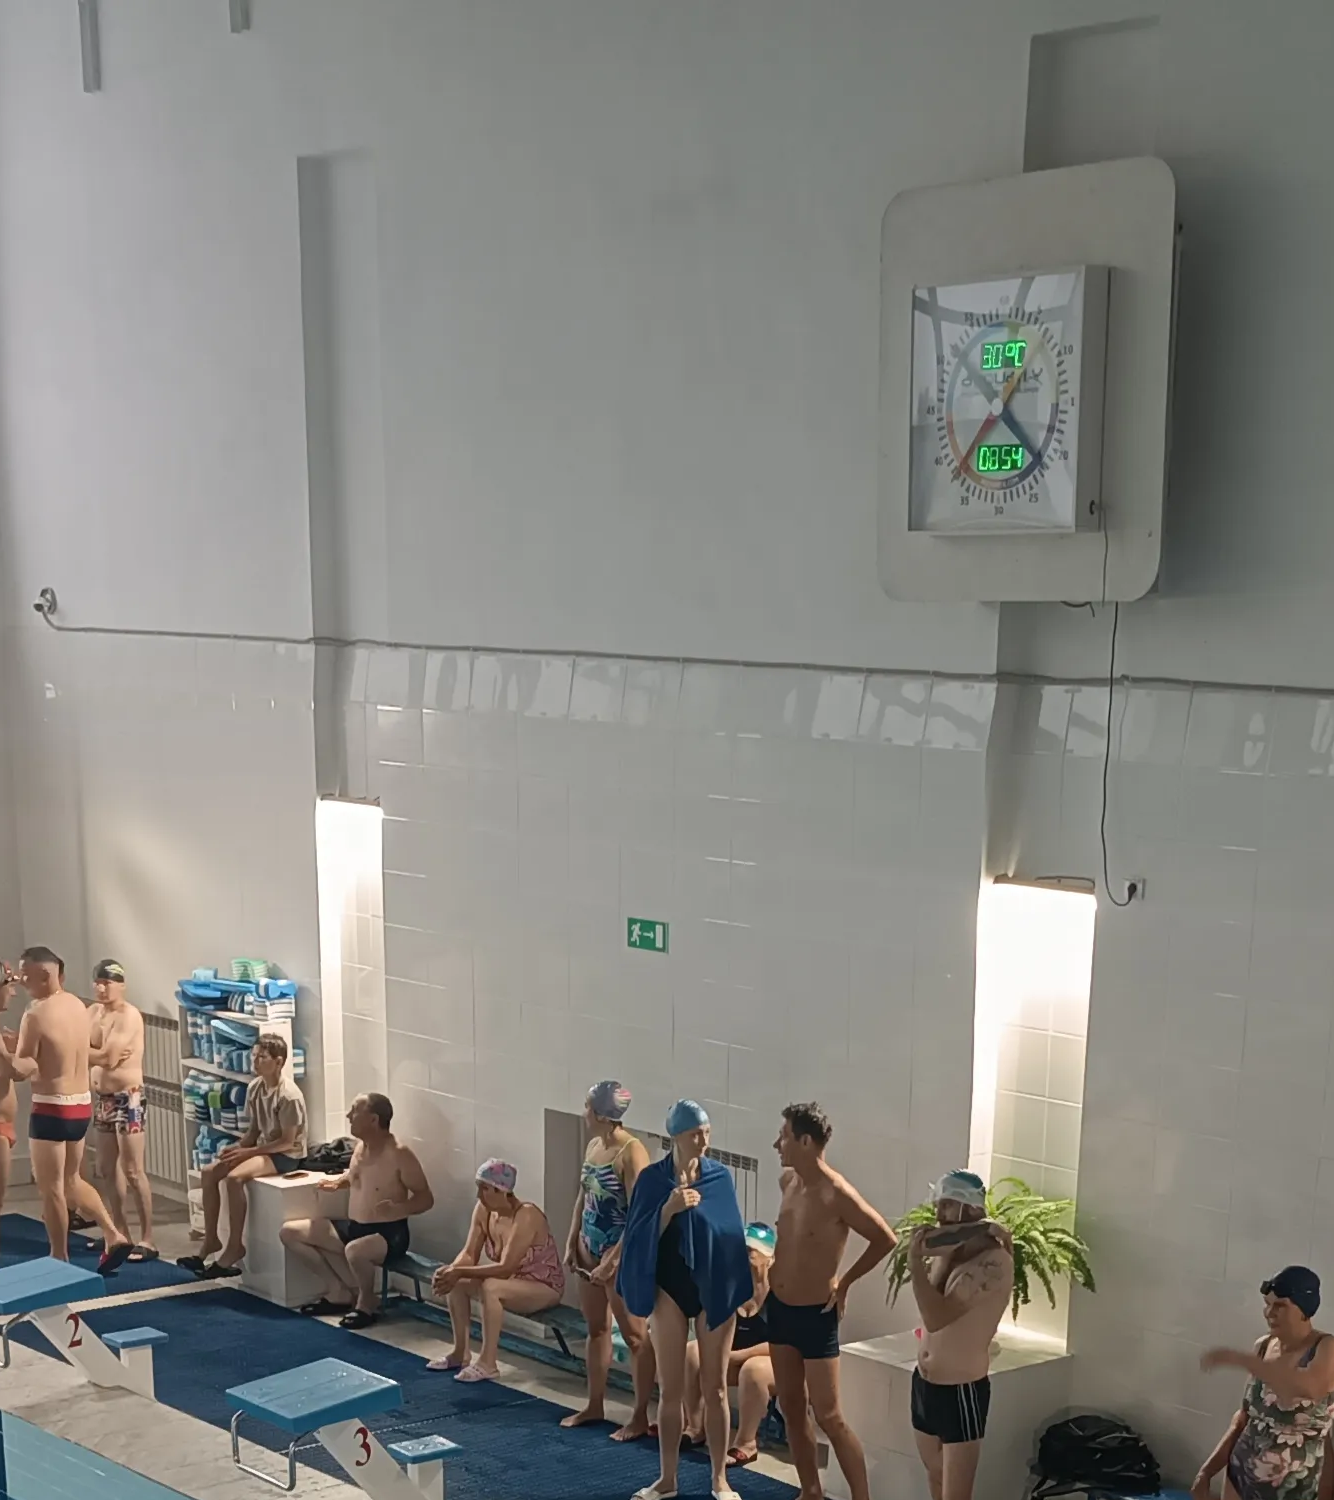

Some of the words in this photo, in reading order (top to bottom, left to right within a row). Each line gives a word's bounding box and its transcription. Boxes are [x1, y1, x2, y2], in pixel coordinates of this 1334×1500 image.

[1063, 344, 1074, 355] 10
[959, 495, 970, 507] 35
[1028, 492, 1039, 504] 25
[993, 505, 1005, 516] 30
[65, 1312, 83, 1349] 2
[354, 1426, 372, 1467] 3
